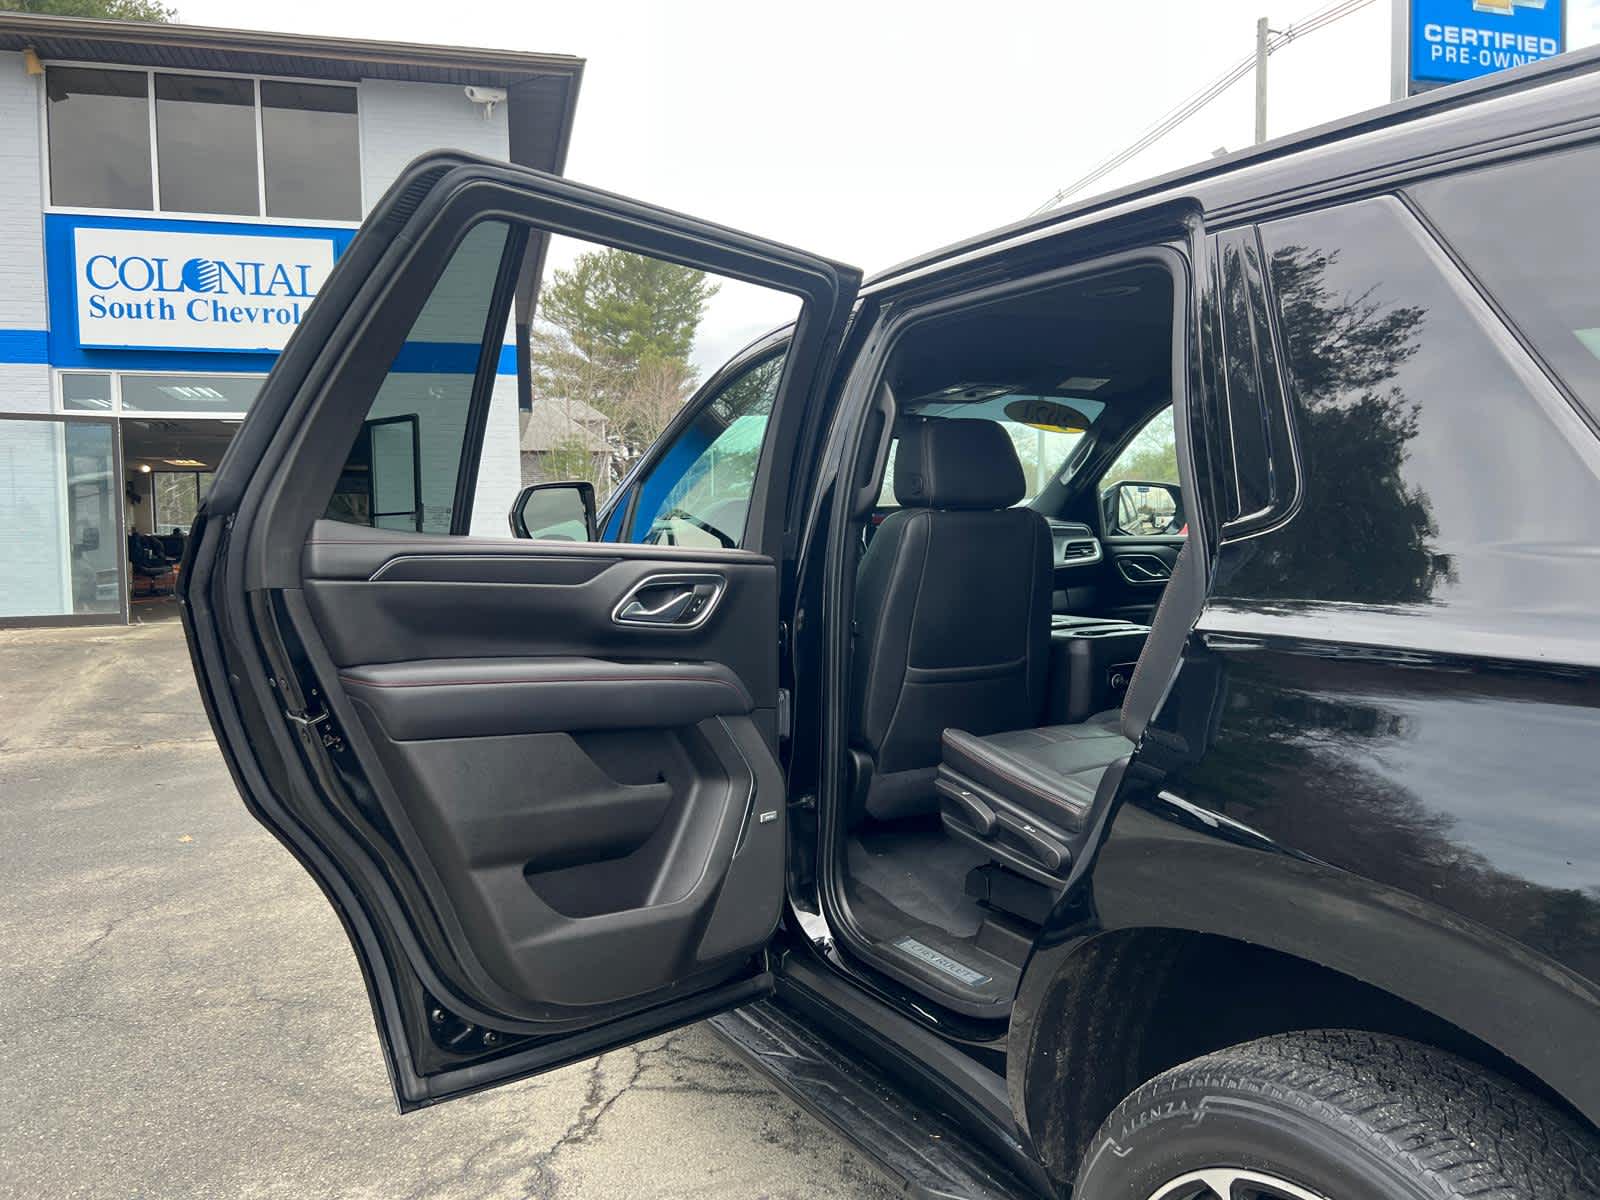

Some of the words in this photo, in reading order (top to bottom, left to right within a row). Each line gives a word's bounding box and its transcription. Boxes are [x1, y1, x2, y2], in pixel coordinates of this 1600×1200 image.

[1424, 23, 1557, 55] CERTIFIED
[1431, 44, 1548, 68] PRE-OWN
[88, 294, 176, 321] South
[186, 298, 300, 325] Chevrol
